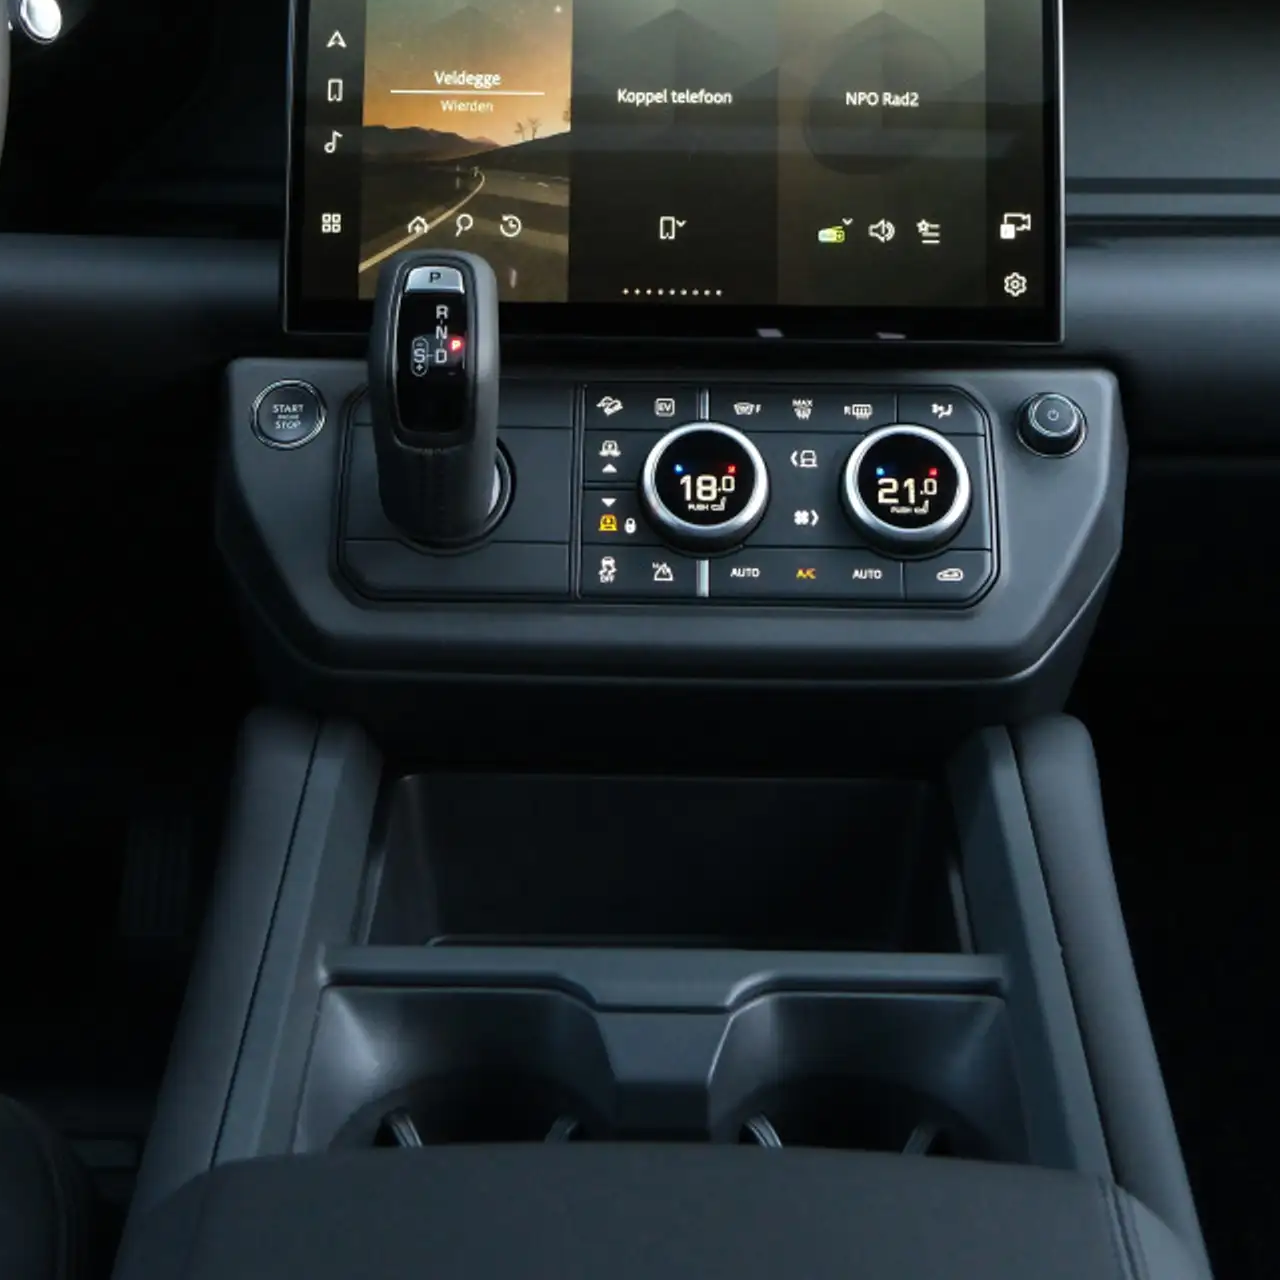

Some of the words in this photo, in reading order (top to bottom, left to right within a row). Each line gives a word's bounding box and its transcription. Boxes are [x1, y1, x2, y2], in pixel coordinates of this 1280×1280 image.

[433, 70, 501, 89] Veldegge
[617, 88, 667, 107] Koppel
[670, 89, 733, 104] telefoon
[845, 92, 879, 106] NPO
[882, 92, 919, 107] Rad2
[440, 100, 494, 112] Wierden
[429, 272, 442, 283] P
[436, 305, 449, 320] R
[435, 325, 448, 340] N
[413, 348, 426, 364] S
[435, 349, 448, 364] D
[272, 404, 304, 413] START
[275, 420, 301, 429] STOP
[680, 474, 736, 502] 18.0
[877, 478, 938, 504] 21.0
[730, 568, 761, 578] AUTO
[852, 569, 883, 580] AUTO
